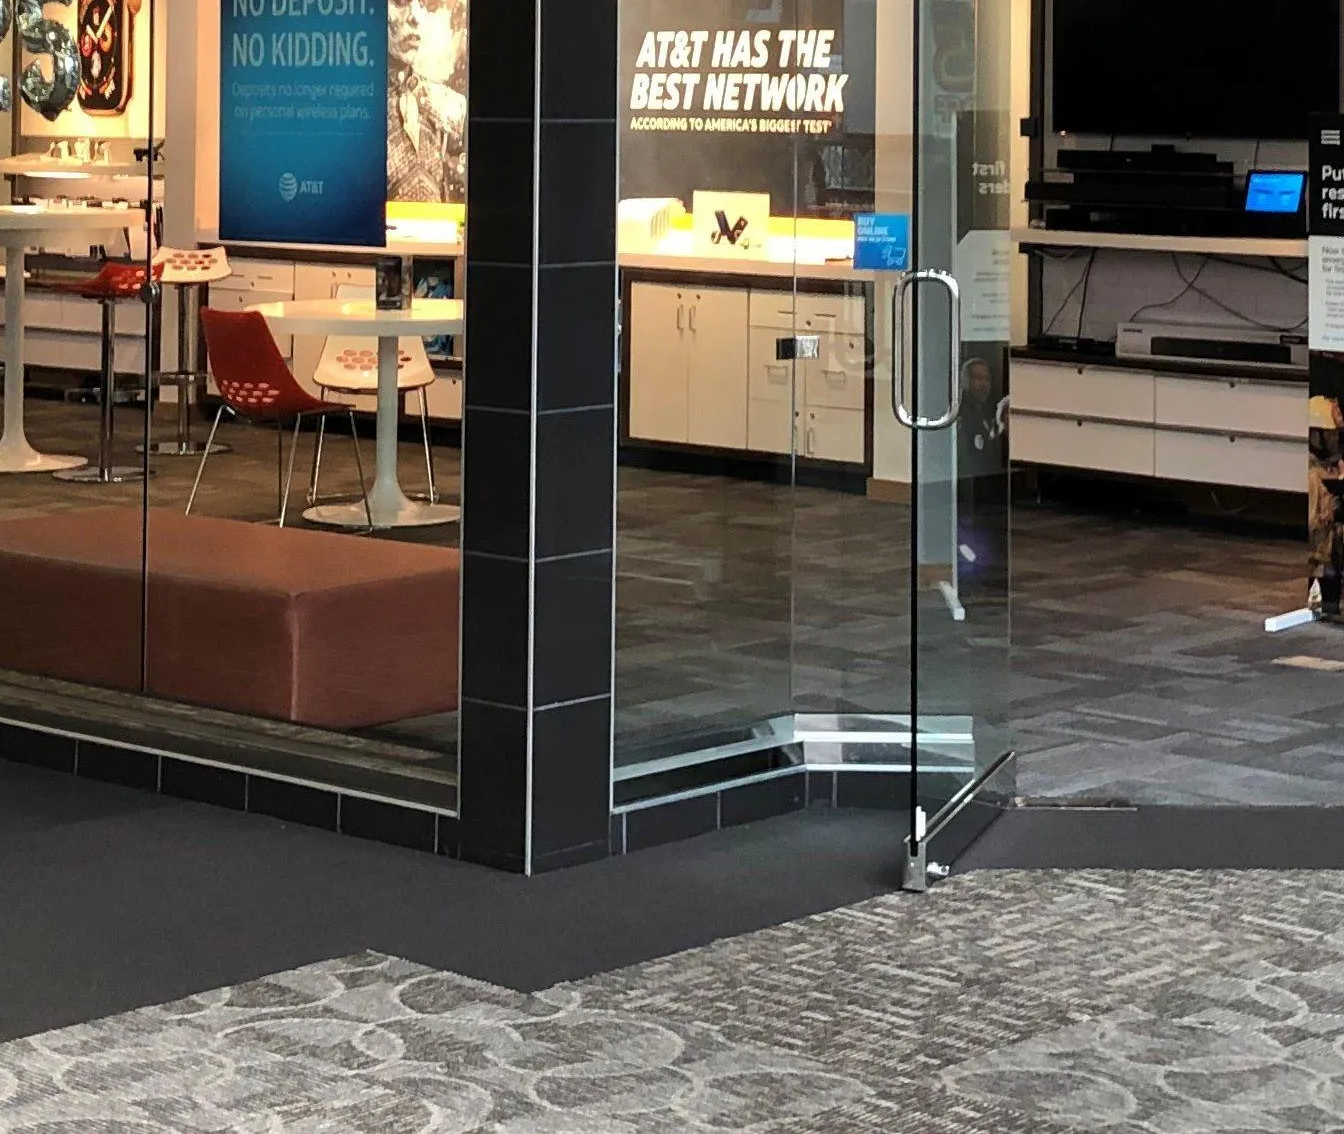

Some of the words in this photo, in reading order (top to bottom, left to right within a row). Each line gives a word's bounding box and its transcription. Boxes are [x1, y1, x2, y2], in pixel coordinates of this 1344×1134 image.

[233, 32, 265, 67] NO
[272, 31, 375, 67] KIDDING.
[635, 30, 709, 68] AT&T
[711, 30, 772, 68] HAS
[778, 30, 835, 68] THE
[630, 73, 701, 110] BEST
[703, 74, 850, 112] NETWORK
[630, 116, 688, 131] ACCORDING
[689, 117, 704, 131] TO
[704, 118, 757, 132] AMERICA'S
[759, 118, 800, 133] BIGGEST
[299, 180, 324, 195] AT&T
